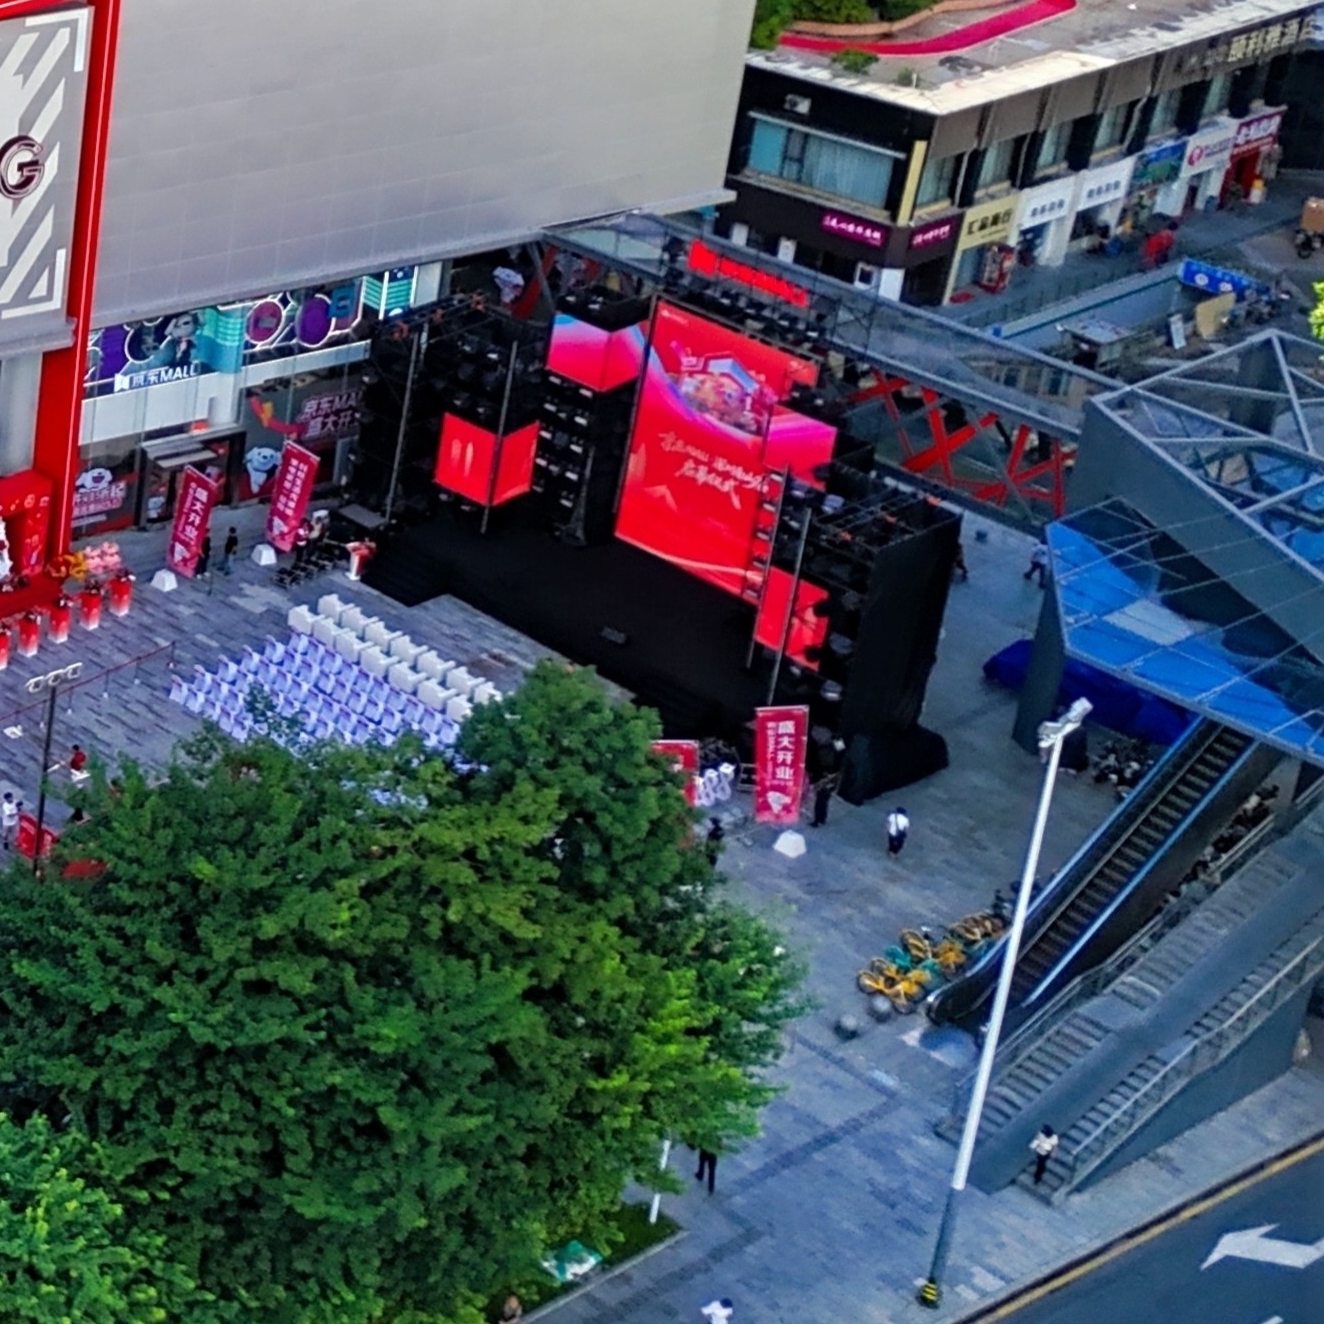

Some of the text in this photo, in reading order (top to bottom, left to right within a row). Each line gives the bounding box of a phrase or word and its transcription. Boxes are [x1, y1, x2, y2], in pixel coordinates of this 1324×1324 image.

[132, 362, 200, 388] 京东MALL
[307, 409, 357, 438] 盛大开
[775, 720, 797, 780] 盛大开业
